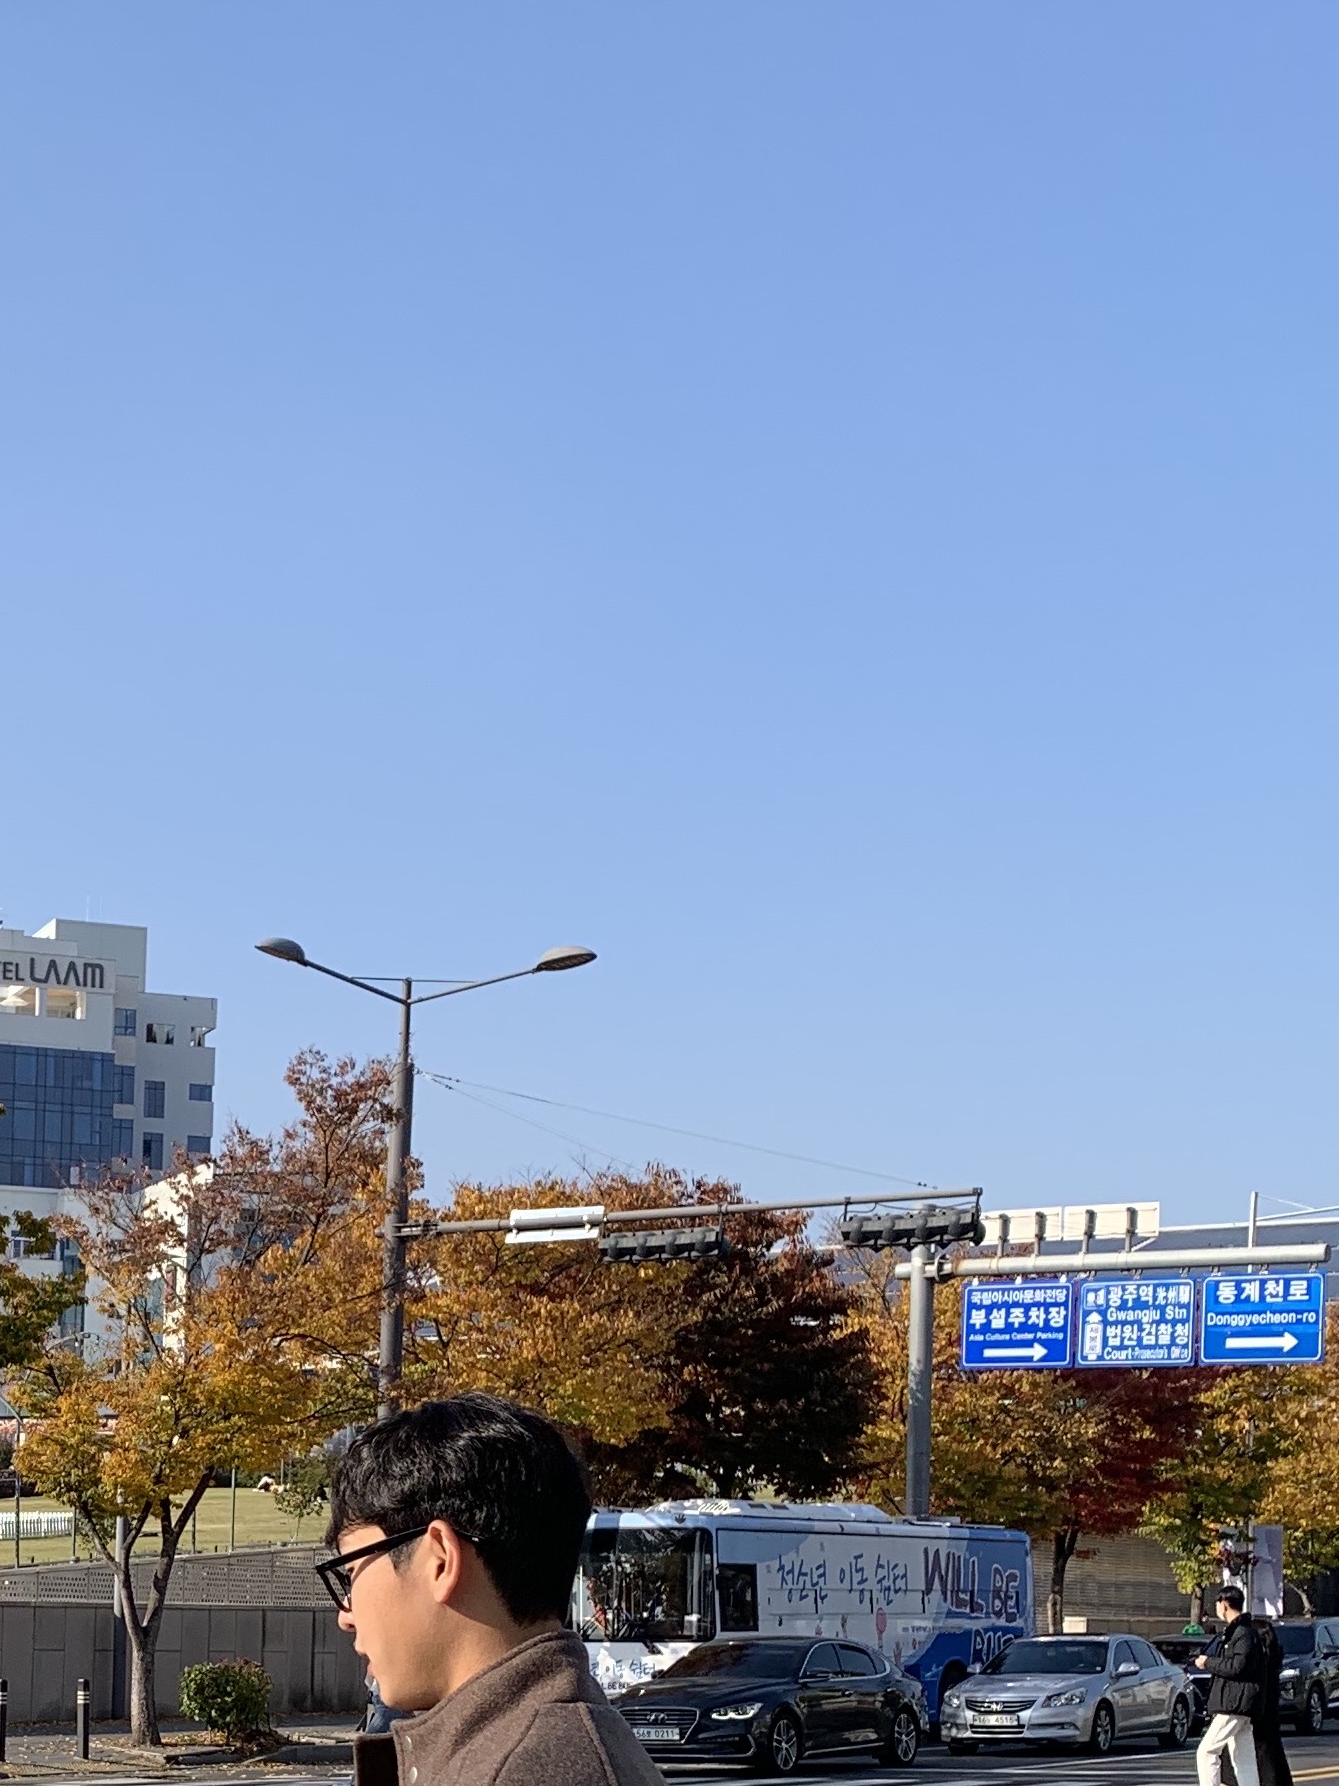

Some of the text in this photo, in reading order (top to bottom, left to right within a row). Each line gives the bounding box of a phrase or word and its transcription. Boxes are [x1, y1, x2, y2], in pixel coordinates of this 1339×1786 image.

[970, 1288, 1068, 1305] 국립아시아문화전당
[1107, 1284, 1154, 1307] 광주역
[1216, 1279, 1310, 1304] 동계천로
[969, 1306, 1067, 1330] 부설주차장
[1107, 1305, 1187, 1323] Gwangju Stn
[1207, 1310, 1316, 1327] Donggyecheon-ro
[969, 1331, 1064, 1341] Asia Culture Center Parking
[777, 1553, 908, 1606] 청소년 이동 쉼터
[923, 1546, 1020, 1625] WILL BE
[654, 1729, 675, 1738] 0211
